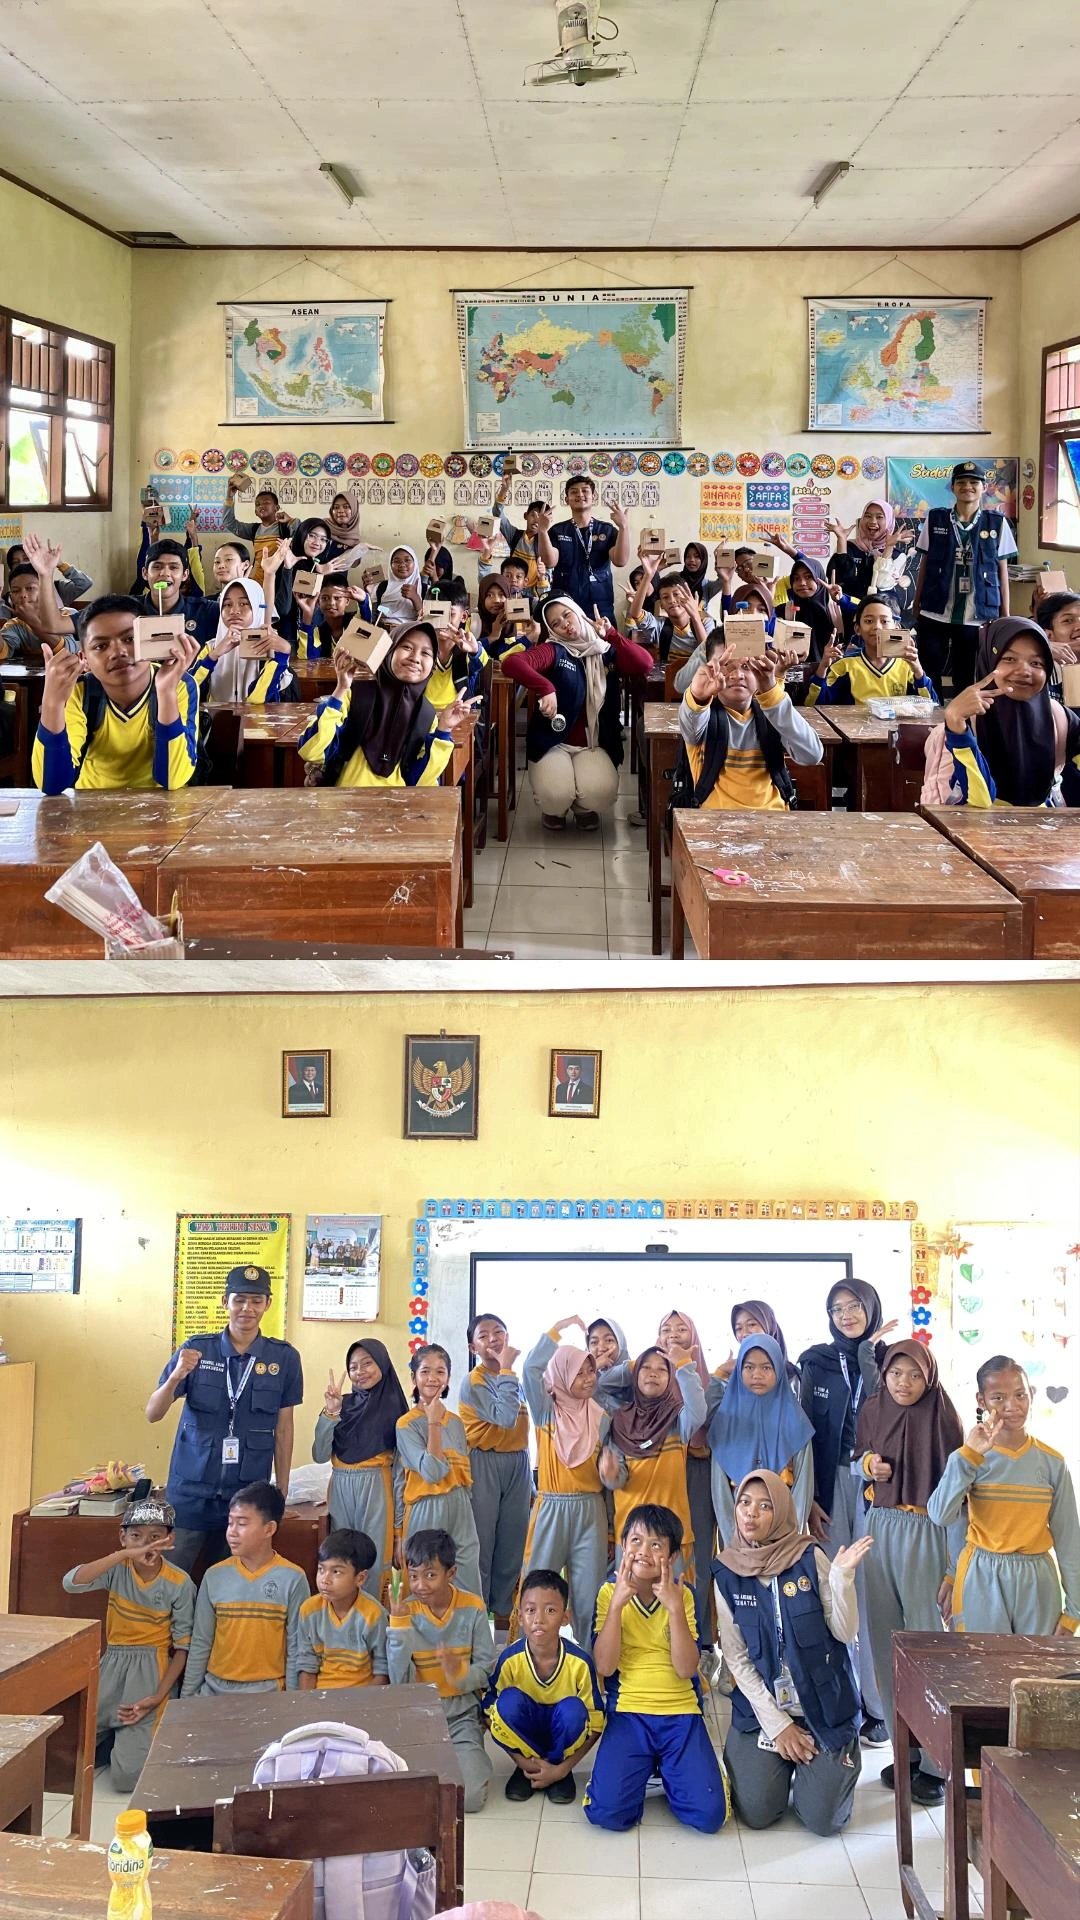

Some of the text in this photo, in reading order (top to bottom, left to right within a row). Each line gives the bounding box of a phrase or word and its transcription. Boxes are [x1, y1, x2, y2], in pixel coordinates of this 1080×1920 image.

[538, 294, 599, 302] DUNIA
[910, 462, 954, 478] Sudut
[755, 491, 782, 500] AFIFA
[109, 1858, 144, 1873] oridina
